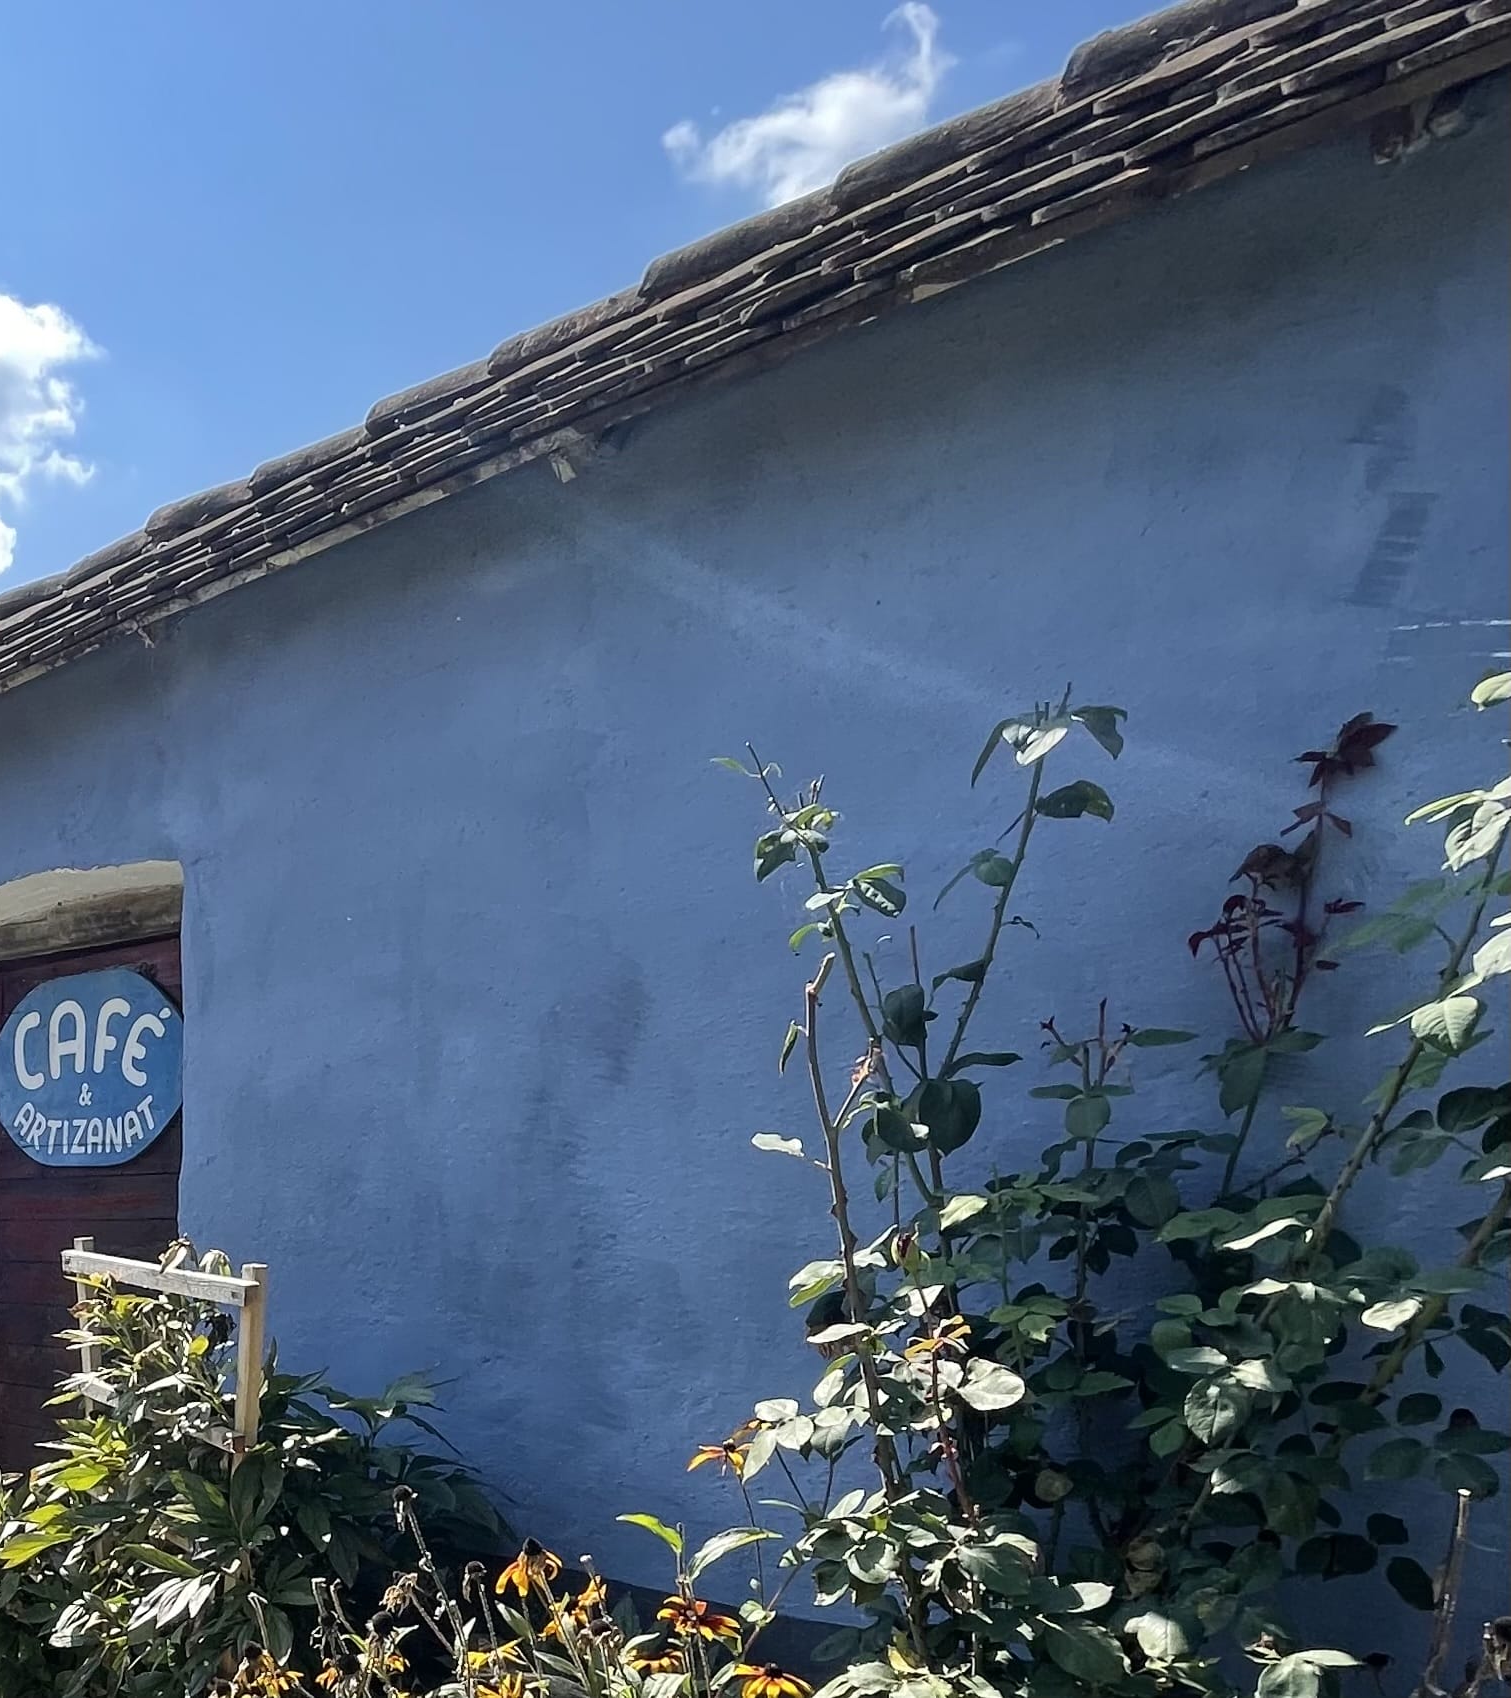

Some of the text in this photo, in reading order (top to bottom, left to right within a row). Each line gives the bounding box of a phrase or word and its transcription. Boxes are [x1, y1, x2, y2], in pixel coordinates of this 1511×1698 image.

[14, 998, 172, 1090] CAFÉ
[78, 1083, 92, 1106] &
[13, 1095, 155, 1155] ARTIZANAT
